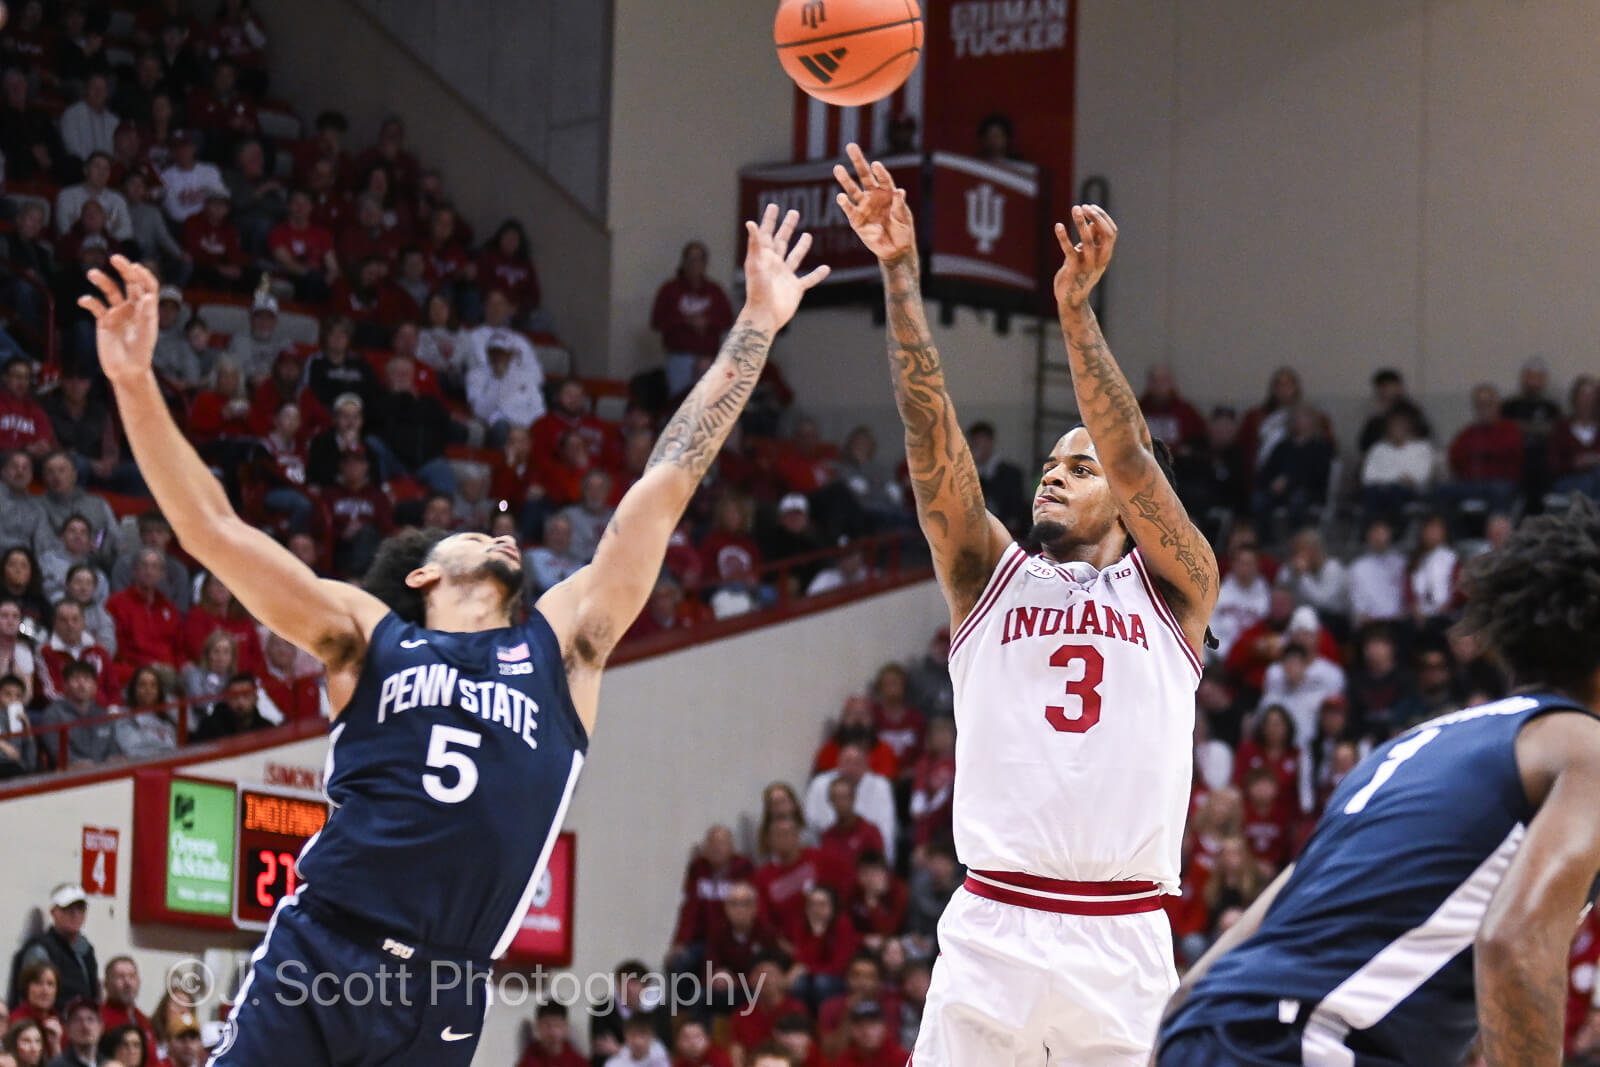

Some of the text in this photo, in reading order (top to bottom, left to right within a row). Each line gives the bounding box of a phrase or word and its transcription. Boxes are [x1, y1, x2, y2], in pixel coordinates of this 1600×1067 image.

[950, 22, 1067, 57] TUCKER
[1001, 600, 1149, 651] INDIANA
[377, 664, 540, 750] PENN STATE
[1045, 645, 1105, 733] 3
[422, 724, 482, 804] 5
[92, 850, 107, 888] 4
